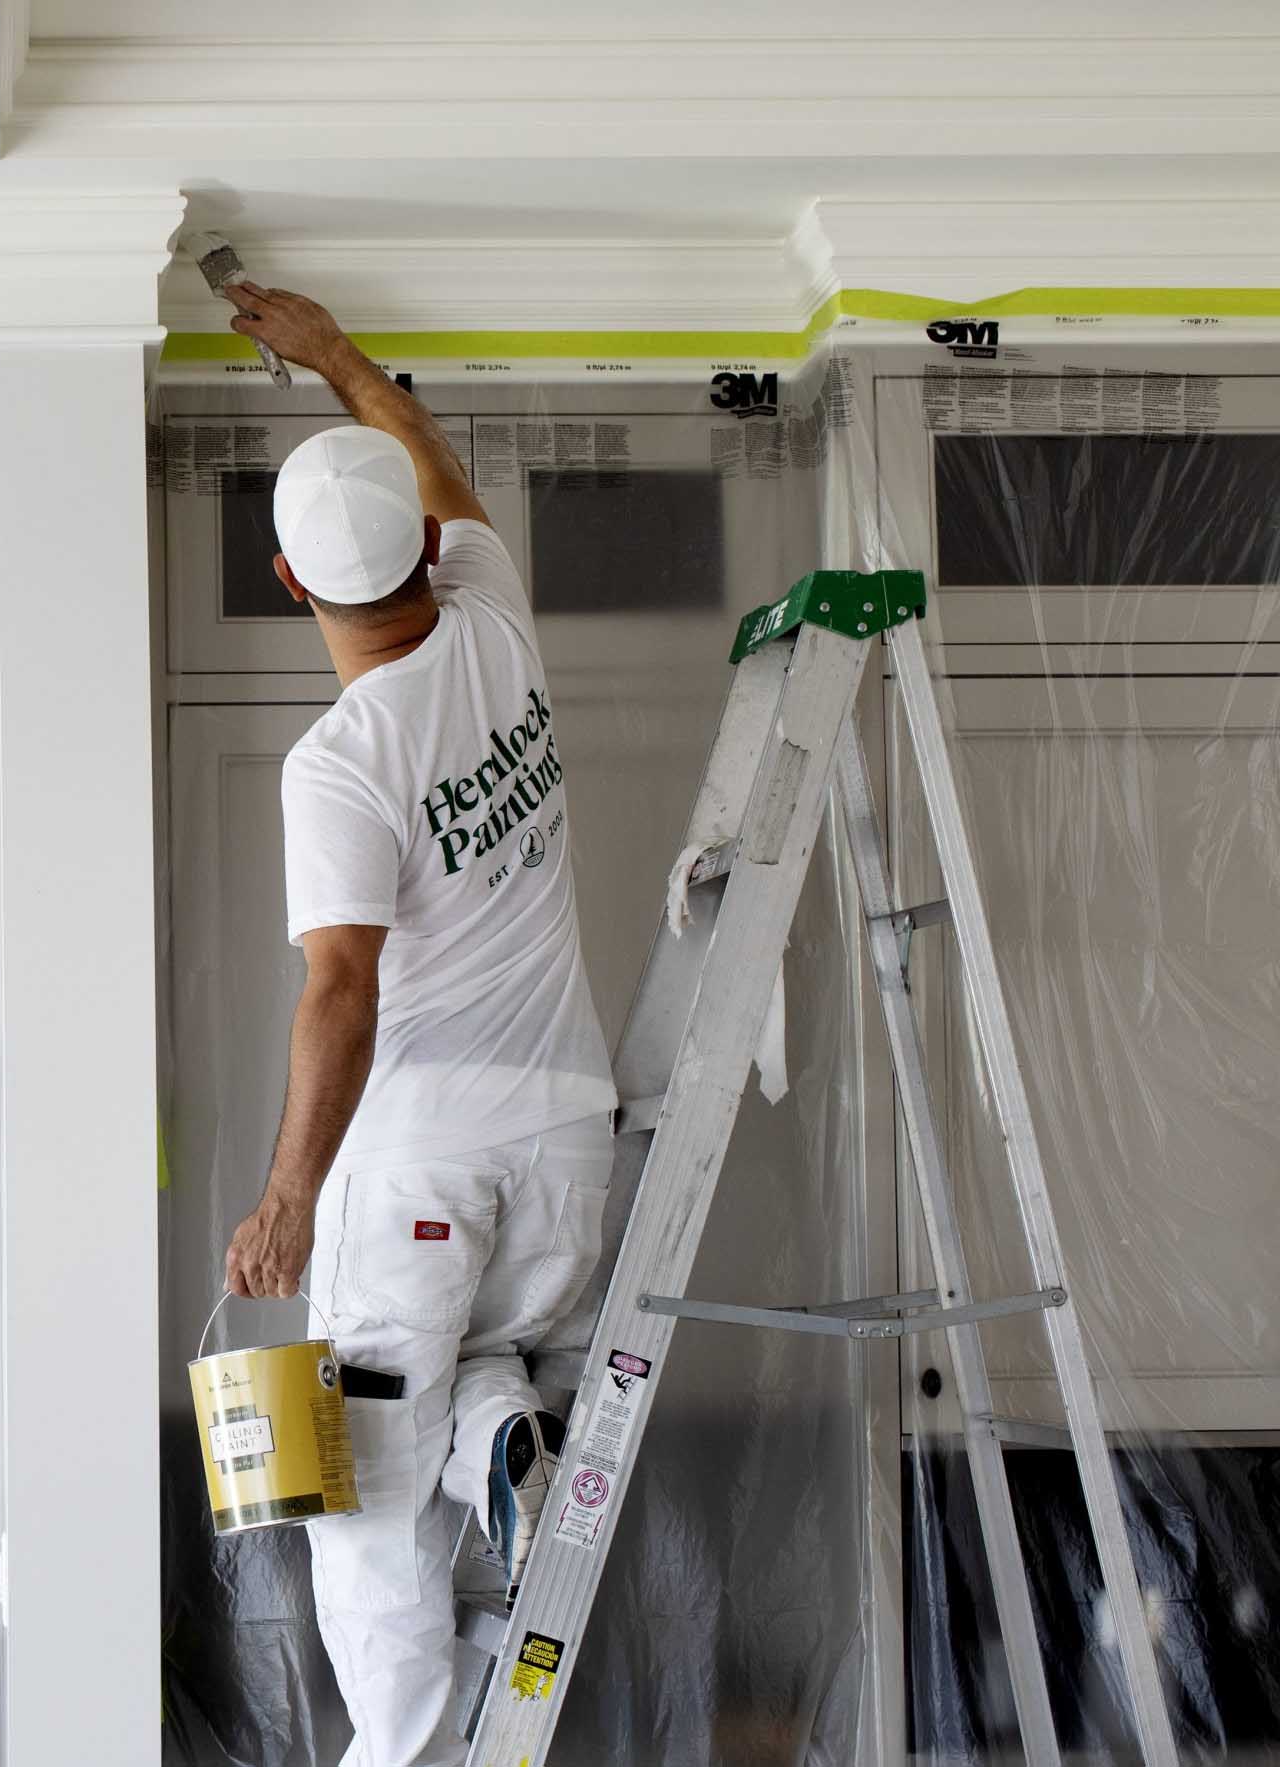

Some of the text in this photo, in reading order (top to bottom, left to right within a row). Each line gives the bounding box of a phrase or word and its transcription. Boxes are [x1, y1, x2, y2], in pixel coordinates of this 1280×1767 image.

[925, 320, 1000, 346] 3M
[710, 372, 778, 410] 3M
[215, 1424, 263, 1443] CILING
[222, 1437, 256, 1451] AINT
